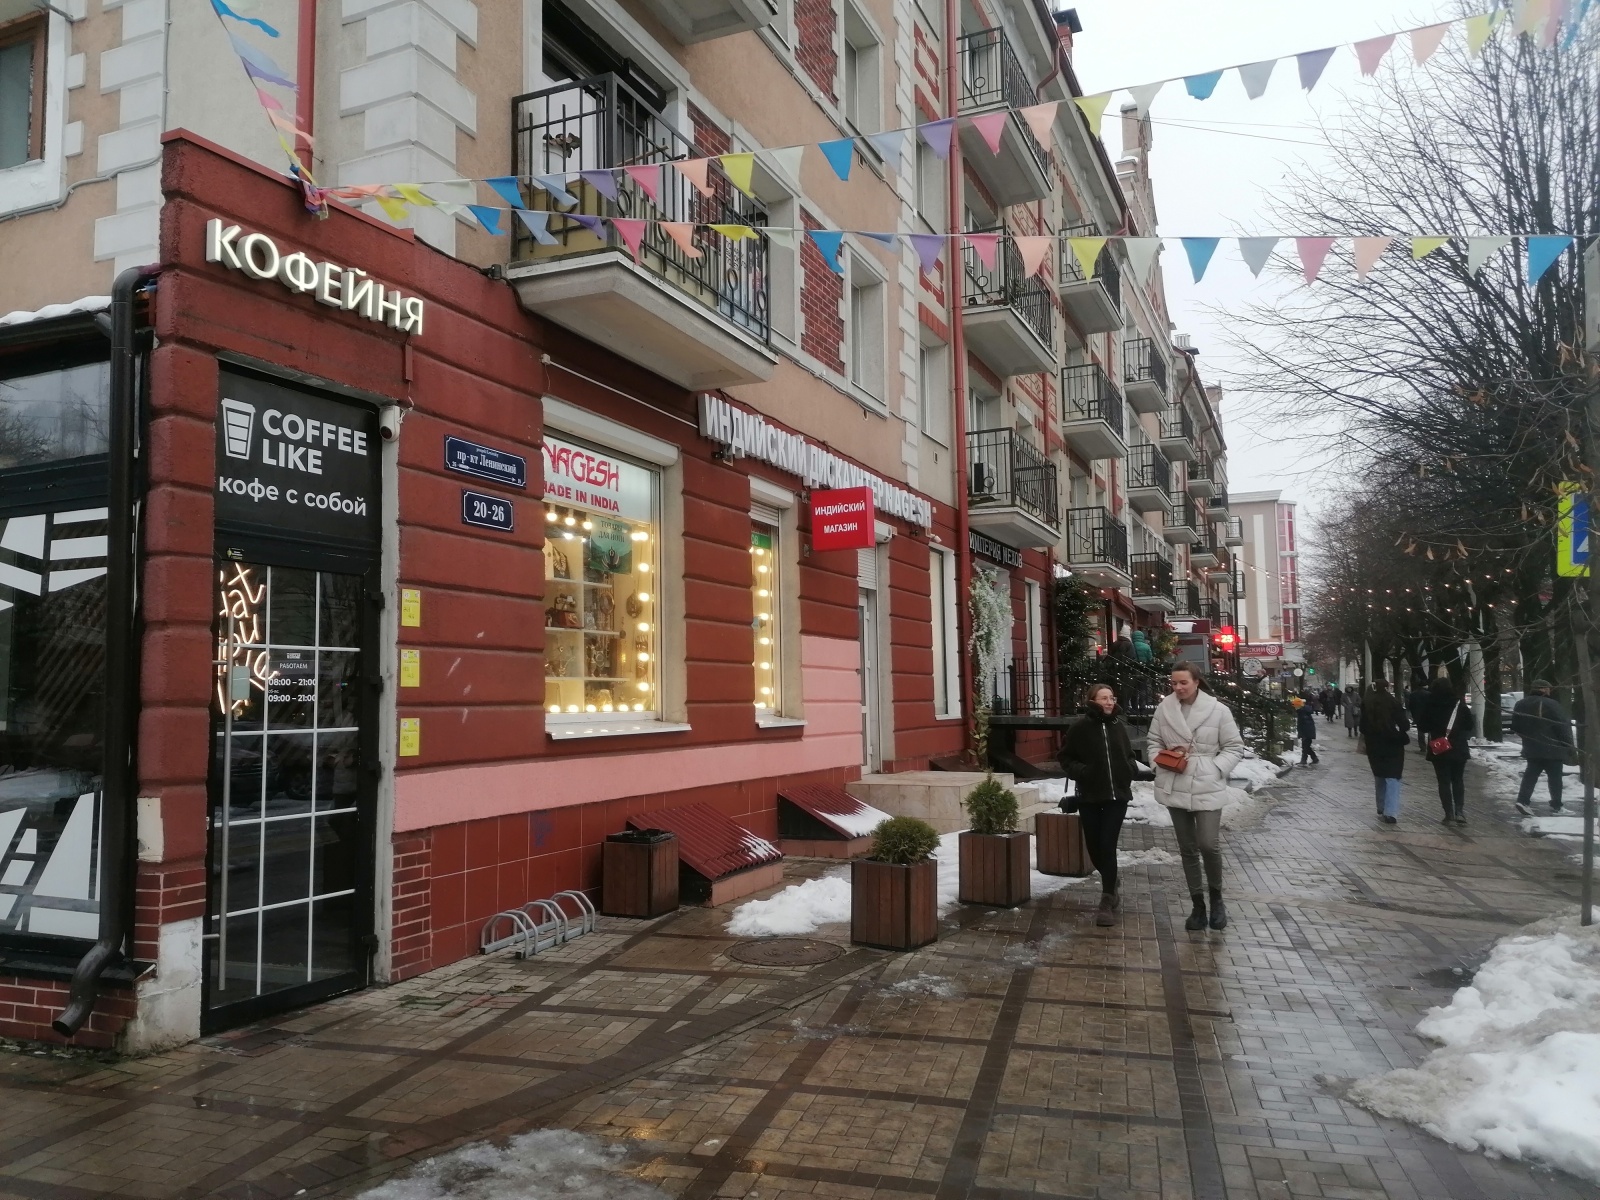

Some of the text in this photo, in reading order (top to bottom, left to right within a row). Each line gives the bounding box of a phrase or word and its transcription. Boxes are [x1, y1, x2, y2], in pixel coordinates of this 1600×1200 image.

[206, 217, 424, 336] КОФЕЙНЯ
[262, 409, 367, 456] COFFEE
[262, 438, 323, 475] LIKE
[480, 453, 517, 475] Ленинский
[700, 393, 807, 477] ИНДИЙСКИЙ
[884, 481, 932, 528] NAGESH
[219, 476, 367, 516] кофе с собой
[575, 489, 587, 503] IN
[590, 493, 619, 512] INDIA
[473, 500, 505, 522] 20-26
[814, 500, 866, 516] ИНДИЙСКИЙ
[823, 522, 858, 534] МАГАЗИН
[268, 678, 291, 686] 08:00
[268, 694, 291, 702] 09:00
